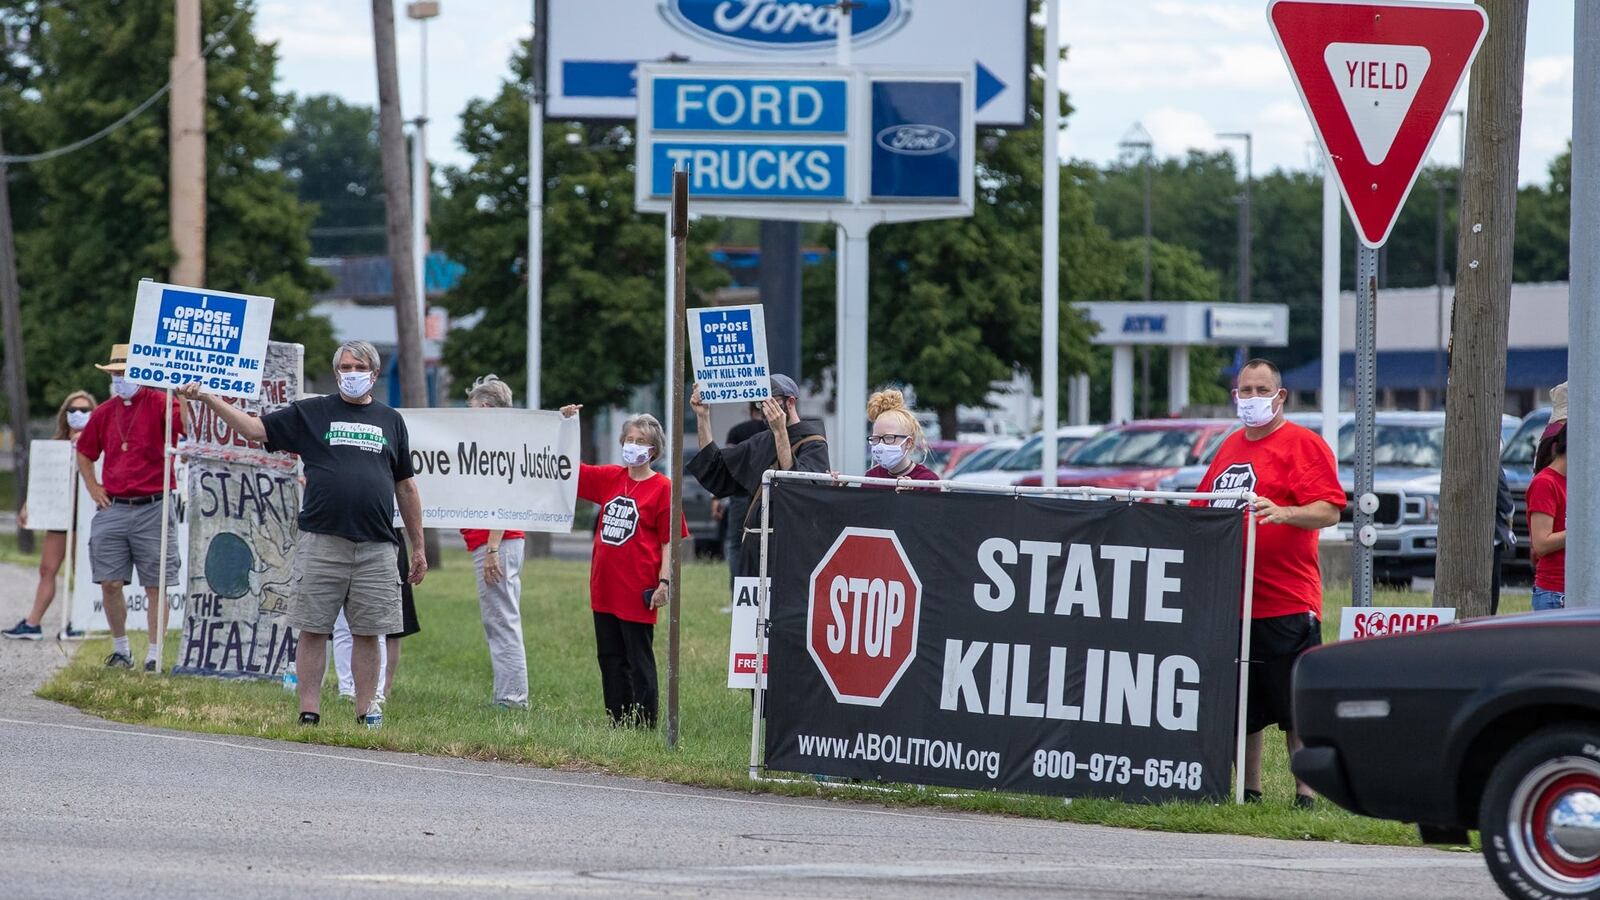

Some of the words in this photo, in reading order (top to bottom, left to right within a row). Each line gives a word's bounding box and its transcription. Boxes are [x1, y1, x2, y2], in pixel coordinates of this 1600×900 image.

[1345, 60, 1409, 90] YIELD
[676, 85, 824, 125] FORD
[891, 127, 941, 149] Ford
[666, 149, 831, 190] TRUCKS
[202, 296, 208, 309] I
[174, 306, 232, 325] OPPOSE
[722, 312, 728, 321] I
[162, 317, 189, 332] THE
[192, 321, 239, 339] DEATH
[704, 321, 749, 333] OPPOSE
[716, 333, 738, 343] THE
[166, 331, 231, 351] PENALTY
[710, 343, 746, 354] DEATH
[132, 343, 172, 359] DON'T
[175, 349, 203, 363] KILL
[207, 353, 235, 367] FOR
[238, 357, 259, 370] ME
[704, 354, 753, 366] PENALTY
[129, 367, 256, 394] 800-973-6548
[697, 369, 718, 380] DON'T
[720, 368, 736, 379] KILL
[737, 367, 753, 378] FOR
[754, 366, 766, 377] ME
[262, 380, 288, 405] THE
[700, 388, 769, 401] 800-973-6548
[325, 431, 355, 440] JOURNEY
[358, 432, 367, 440] OF
[410, 449, 451, 476] ove
[457, 442, 515, 485] Mercy
[520, 443, 572, 481] Justice
[1220, 472, 1250, 488] STOP
[200, 471, 291, 525] START
[603, 525, 626, 539] NOW!
[191, 593, 224, 618] THE
[826, 574, 905, 658] STOP
[973, 537, 1185, 624] STATE
[184, 616, 298, 675] HEALIN
[737, 659, 764, 669] FRE
[940, 638, 1200, 731] KILLING
[798, 732, 1000, 779] www.ABOLITION.org
[1033, 749, 1202, 791] 800-973-6548
